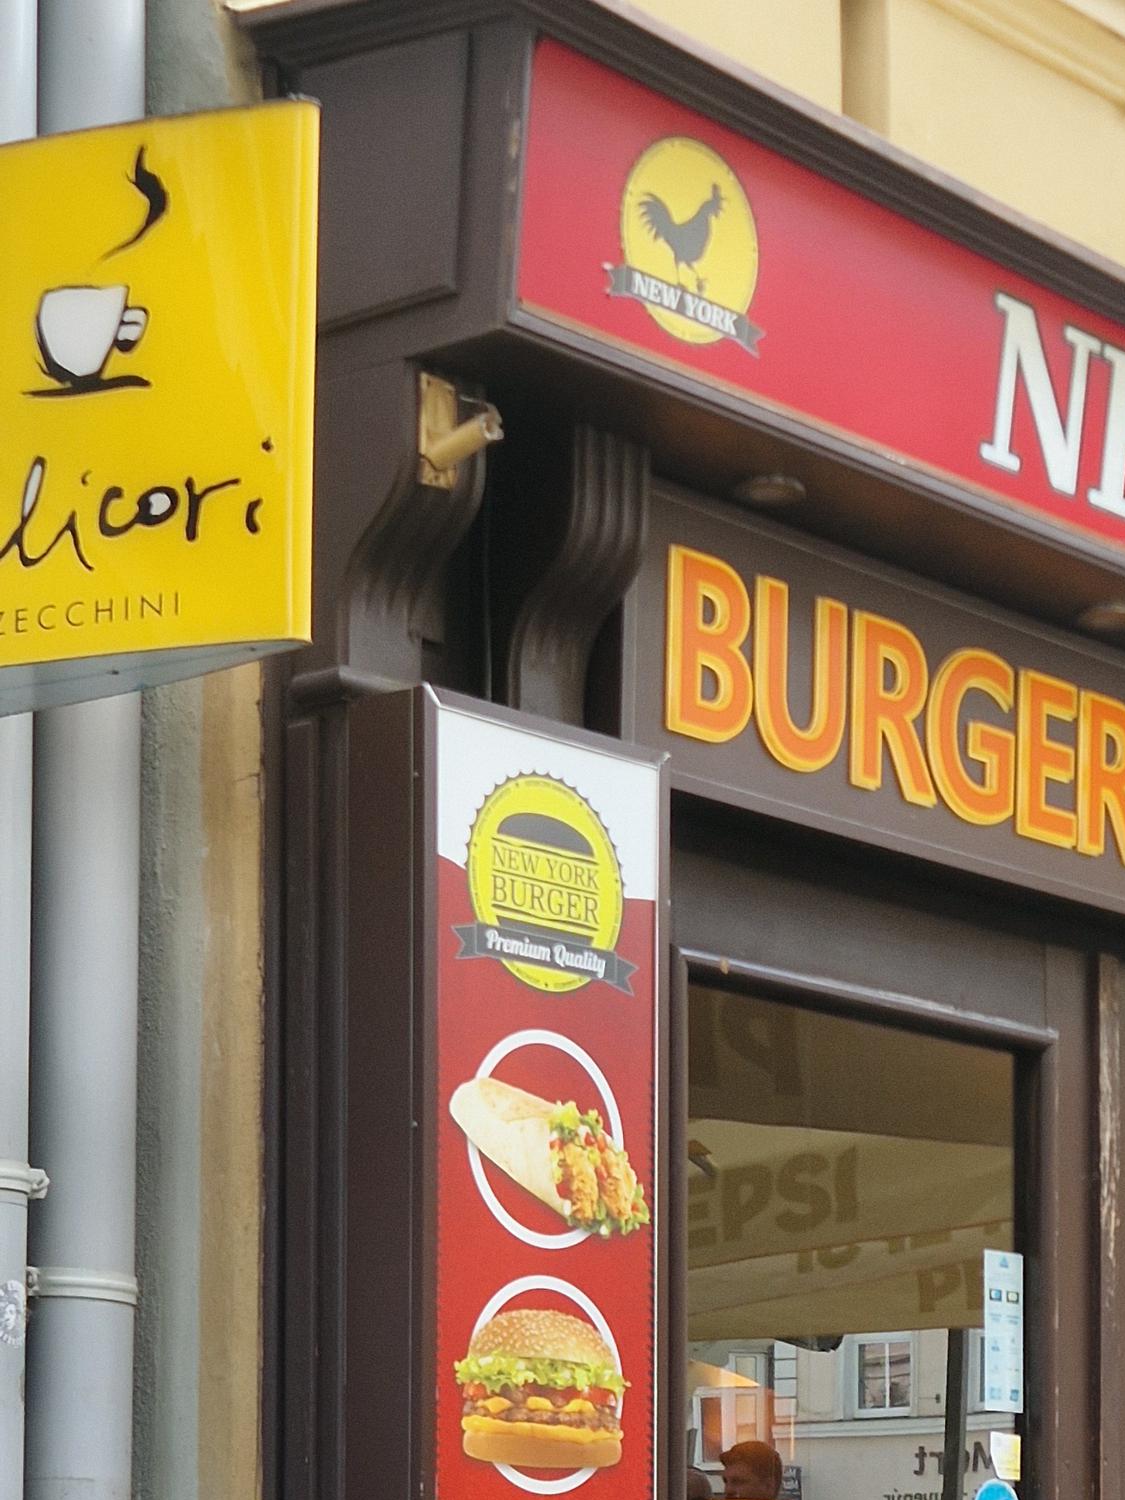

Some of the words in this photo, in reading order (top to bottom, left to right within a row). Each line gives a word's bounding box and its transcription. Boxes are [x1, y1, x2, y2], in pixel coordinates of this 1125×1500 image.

[631, 271, 682, 311] NEW
[683, 289, 739, 336] YORK
[492, 845, 540, 872] NEW
[546, 858, 600, 890] YORK
[492, 874, 600, 925] BURGER
[485, 929, 551, 961] Premium
[553, 944, 606, 978] Quality
